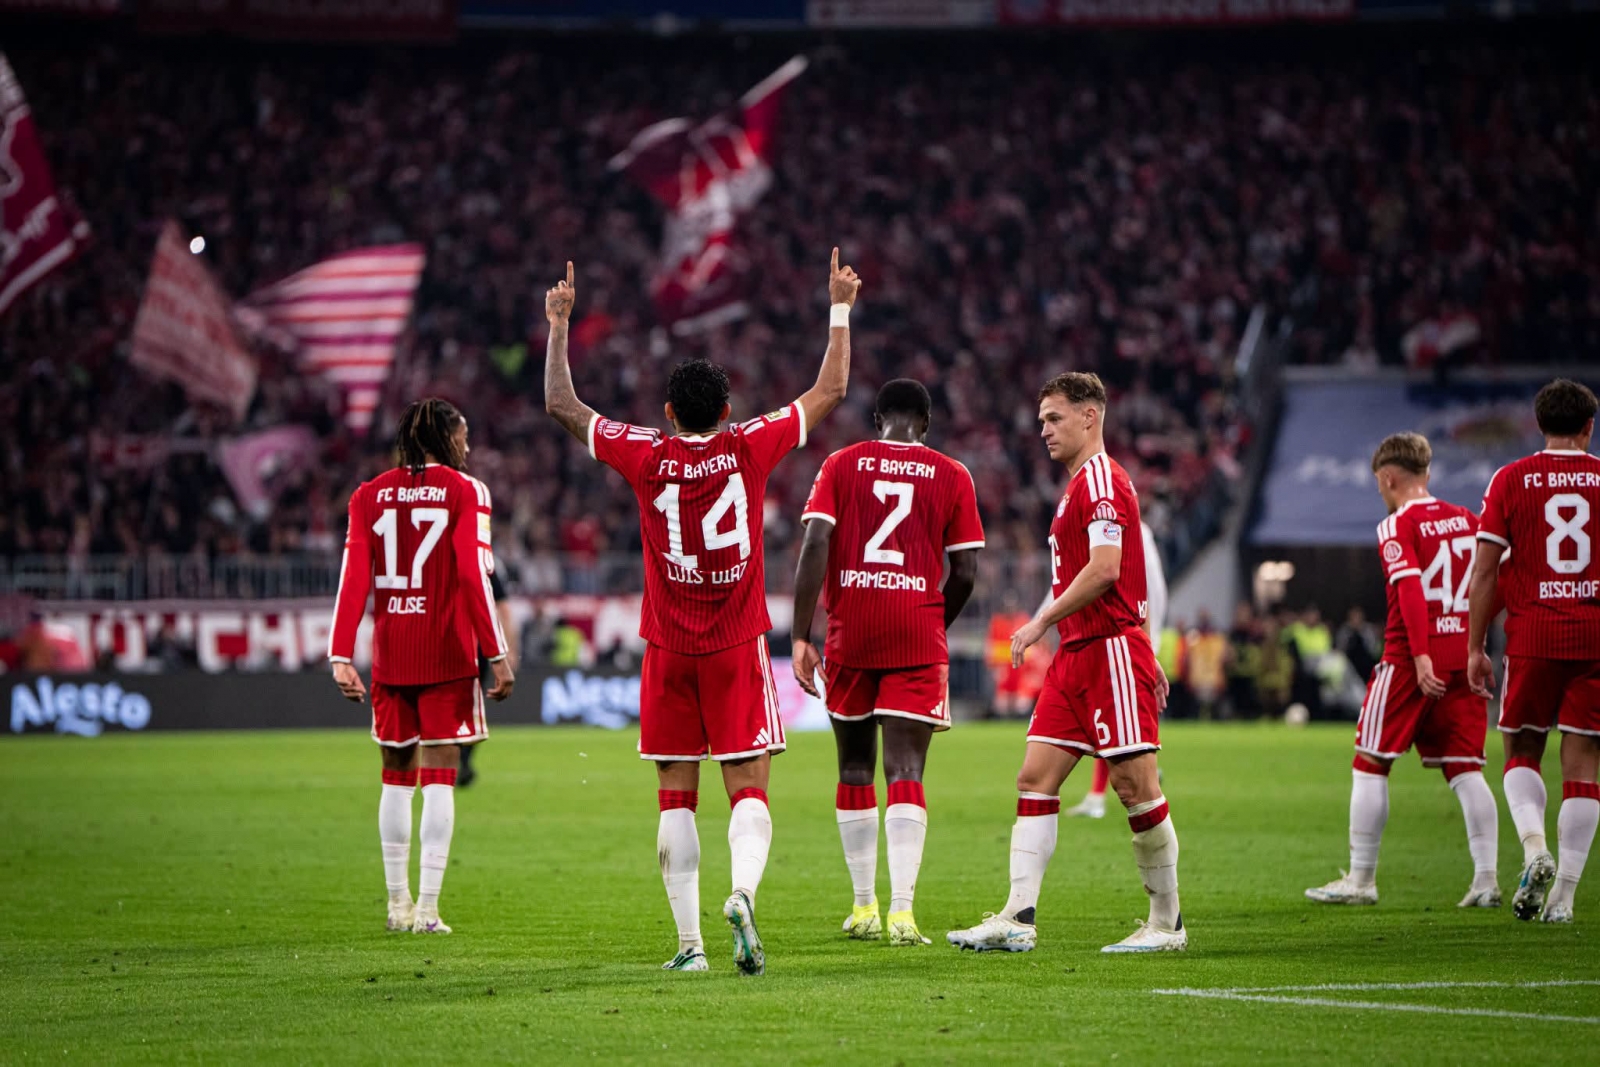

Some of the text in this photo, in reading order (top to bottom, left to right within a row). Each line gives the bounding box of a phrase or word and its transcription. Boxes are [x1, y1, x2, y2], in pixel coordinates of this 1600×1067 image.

[658, 453, 738, 478] FC BAYERN
[857, 457, 936, 479] FC BAYERN
[1524, 473, 1543, 489] FC
[376, 486, 447, 503] FC BAYERN
[653, 472, 751, 568] 14
[863, 479, 915, 567] 2
[1419, 521, 1435, 537] FC
[1544, 493, 1591, 574] 8
[372, 507, 449, 590] 17
[666, 563, 704, 584] LUIS
[840, 569, 926, 592] UPAMECANO
[1421, 535, 1477, 615] 42
[1539, 580, 1600, 600] BISCHOF
[387, 596, 427, 614] OLISE
[1436, 616, 1466, 633] KARL
[1093, 708, 1112, 746] 6
